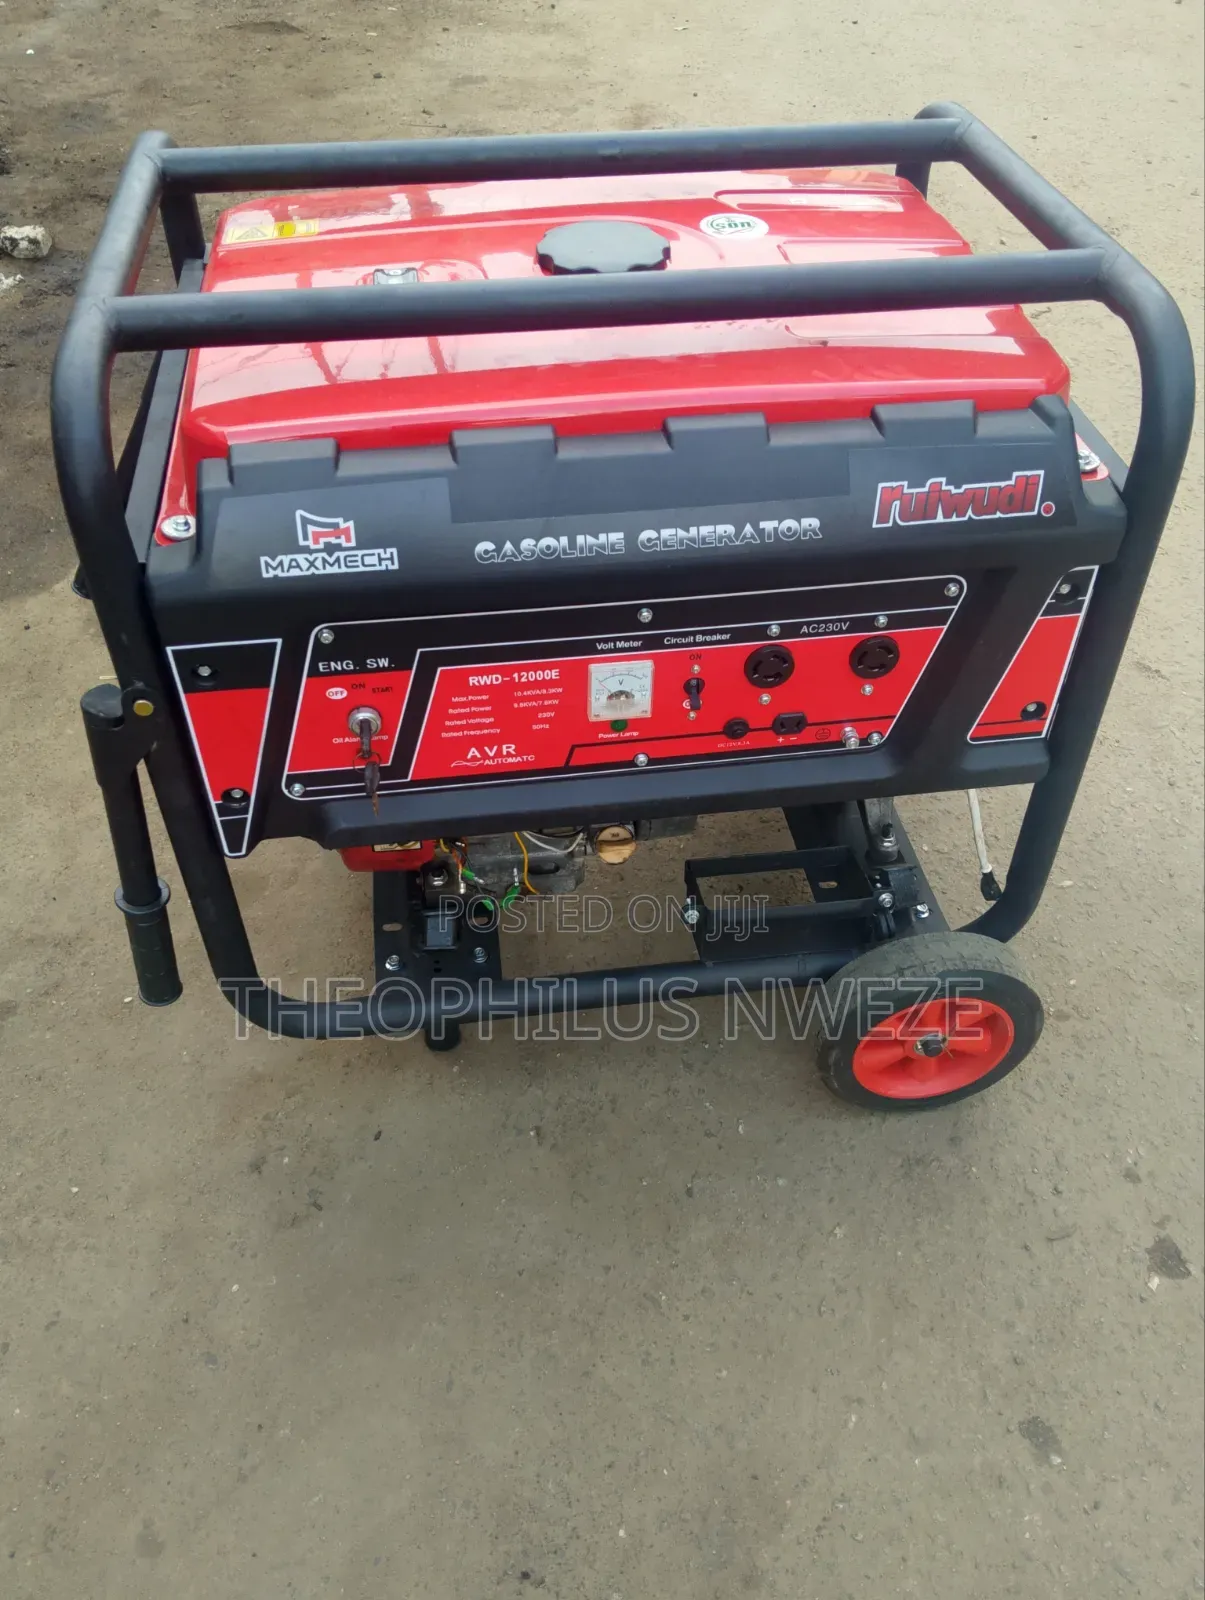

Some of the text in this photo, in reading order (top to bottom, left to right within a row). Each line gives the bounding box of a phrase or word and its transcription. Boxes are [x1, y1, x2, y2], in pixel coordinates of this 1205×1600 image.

[872, 470, 1045, 528] ruiwudi
[474, 517, 823, 564] GASOLINE GENERATOR
[260, 548, 399, 578] MAXMECH
[800, 621, 850, 634] AC230V
[596, 640, 643, 650] Volt Meter
[664, 633, 731, 645] Circuit Breaker
[689, 653, 702, 661] ON
[318, 657, 395, 672] ENG. SW.
[371, 686, 394, 694] START
[468, 717, 494, 725] Voltage
[464, 728, 501, 736] Frequency
